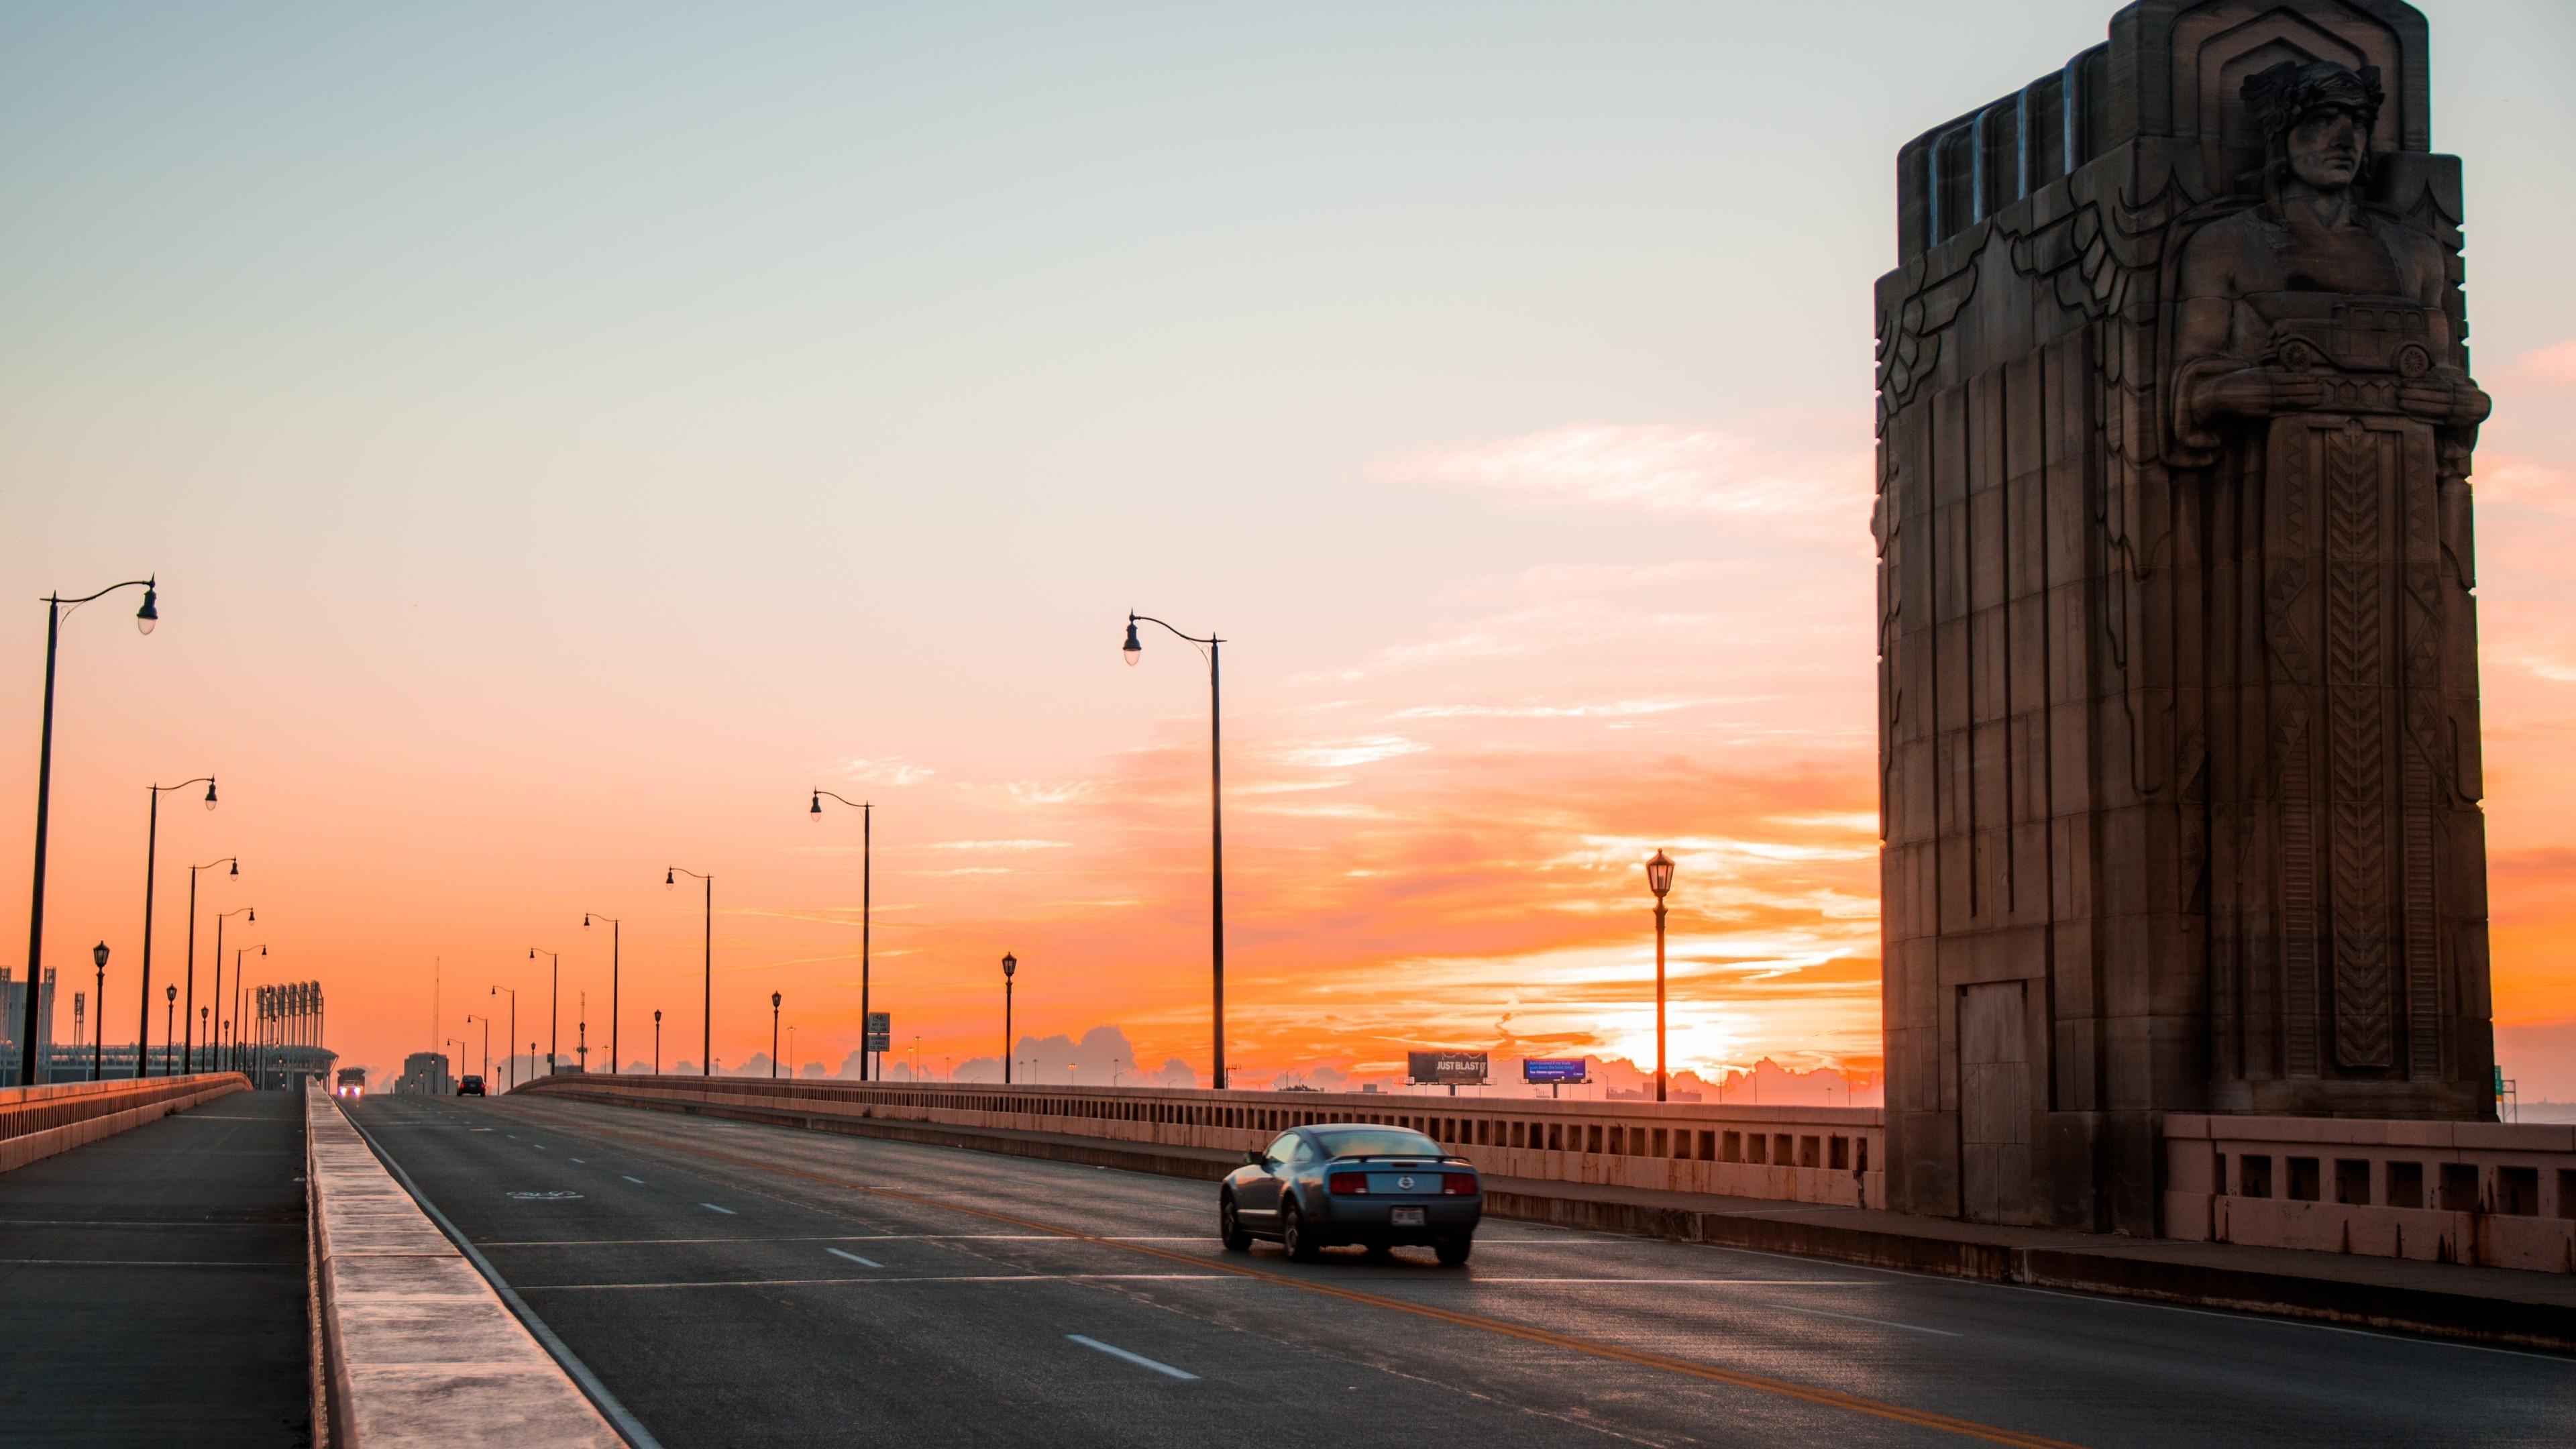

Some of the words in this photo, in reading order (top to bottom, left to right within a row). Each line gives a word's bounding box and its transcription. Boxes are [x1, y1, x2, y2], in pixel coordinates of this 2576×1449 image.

[1437, 1061, 1454, 1070] JUST
[1455, 1061, 1479, 1070] BLAST
[1480, 1062, 1486, 1071] IT
